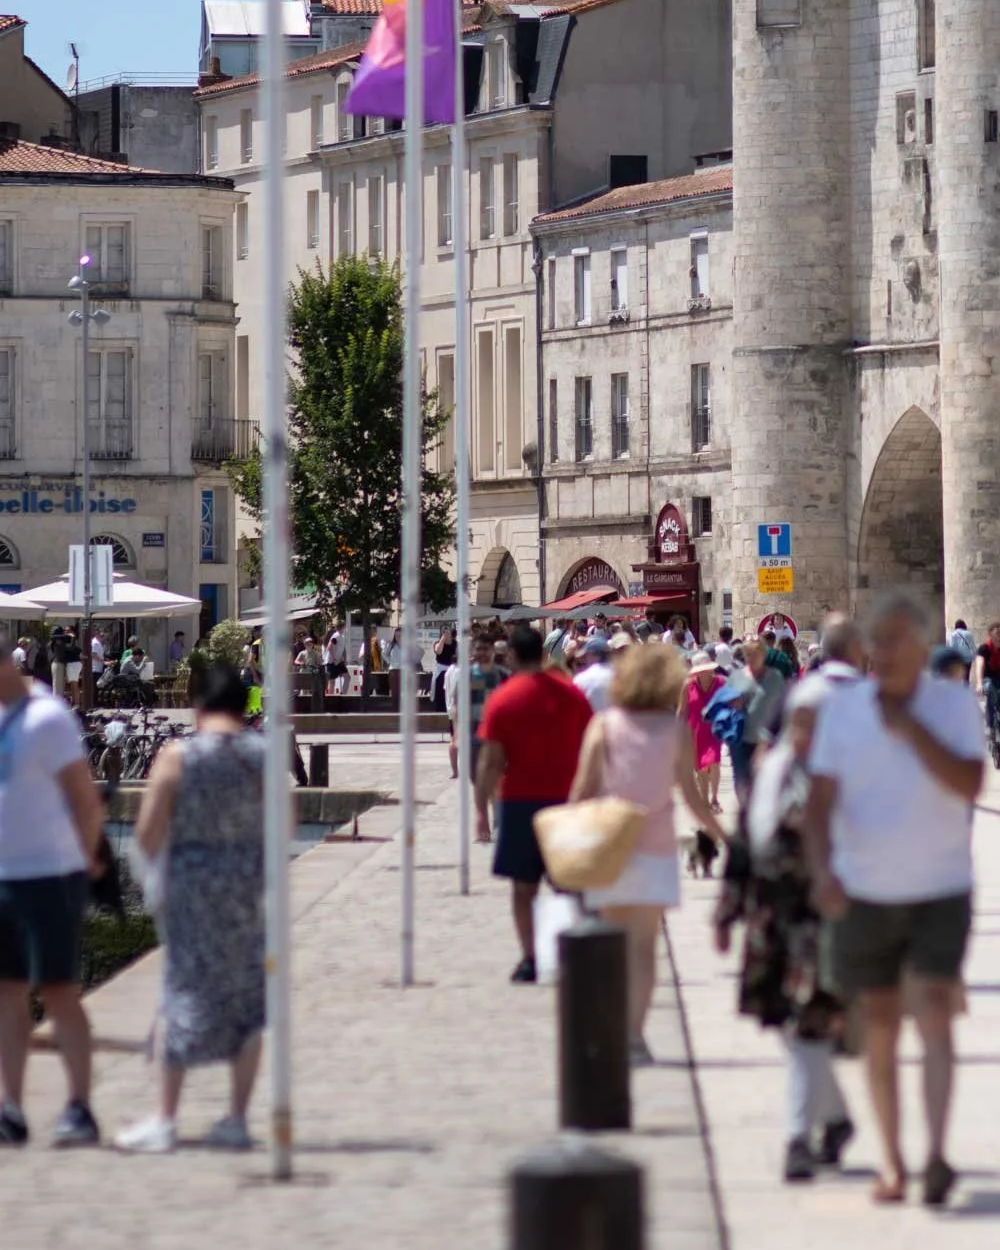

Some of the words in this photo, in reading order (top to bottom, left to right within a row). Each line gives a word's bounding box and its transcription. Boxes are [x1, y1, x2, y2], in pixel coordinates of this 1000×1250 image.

[0, 487, 137, 513] elle-iloise
[659, 517, 680, 538] SNACK
[661, 541, 679, 553] KEBAB
[769, 559, 779, 567] 50
[572, 564, 621, 592] RESTAURAN
